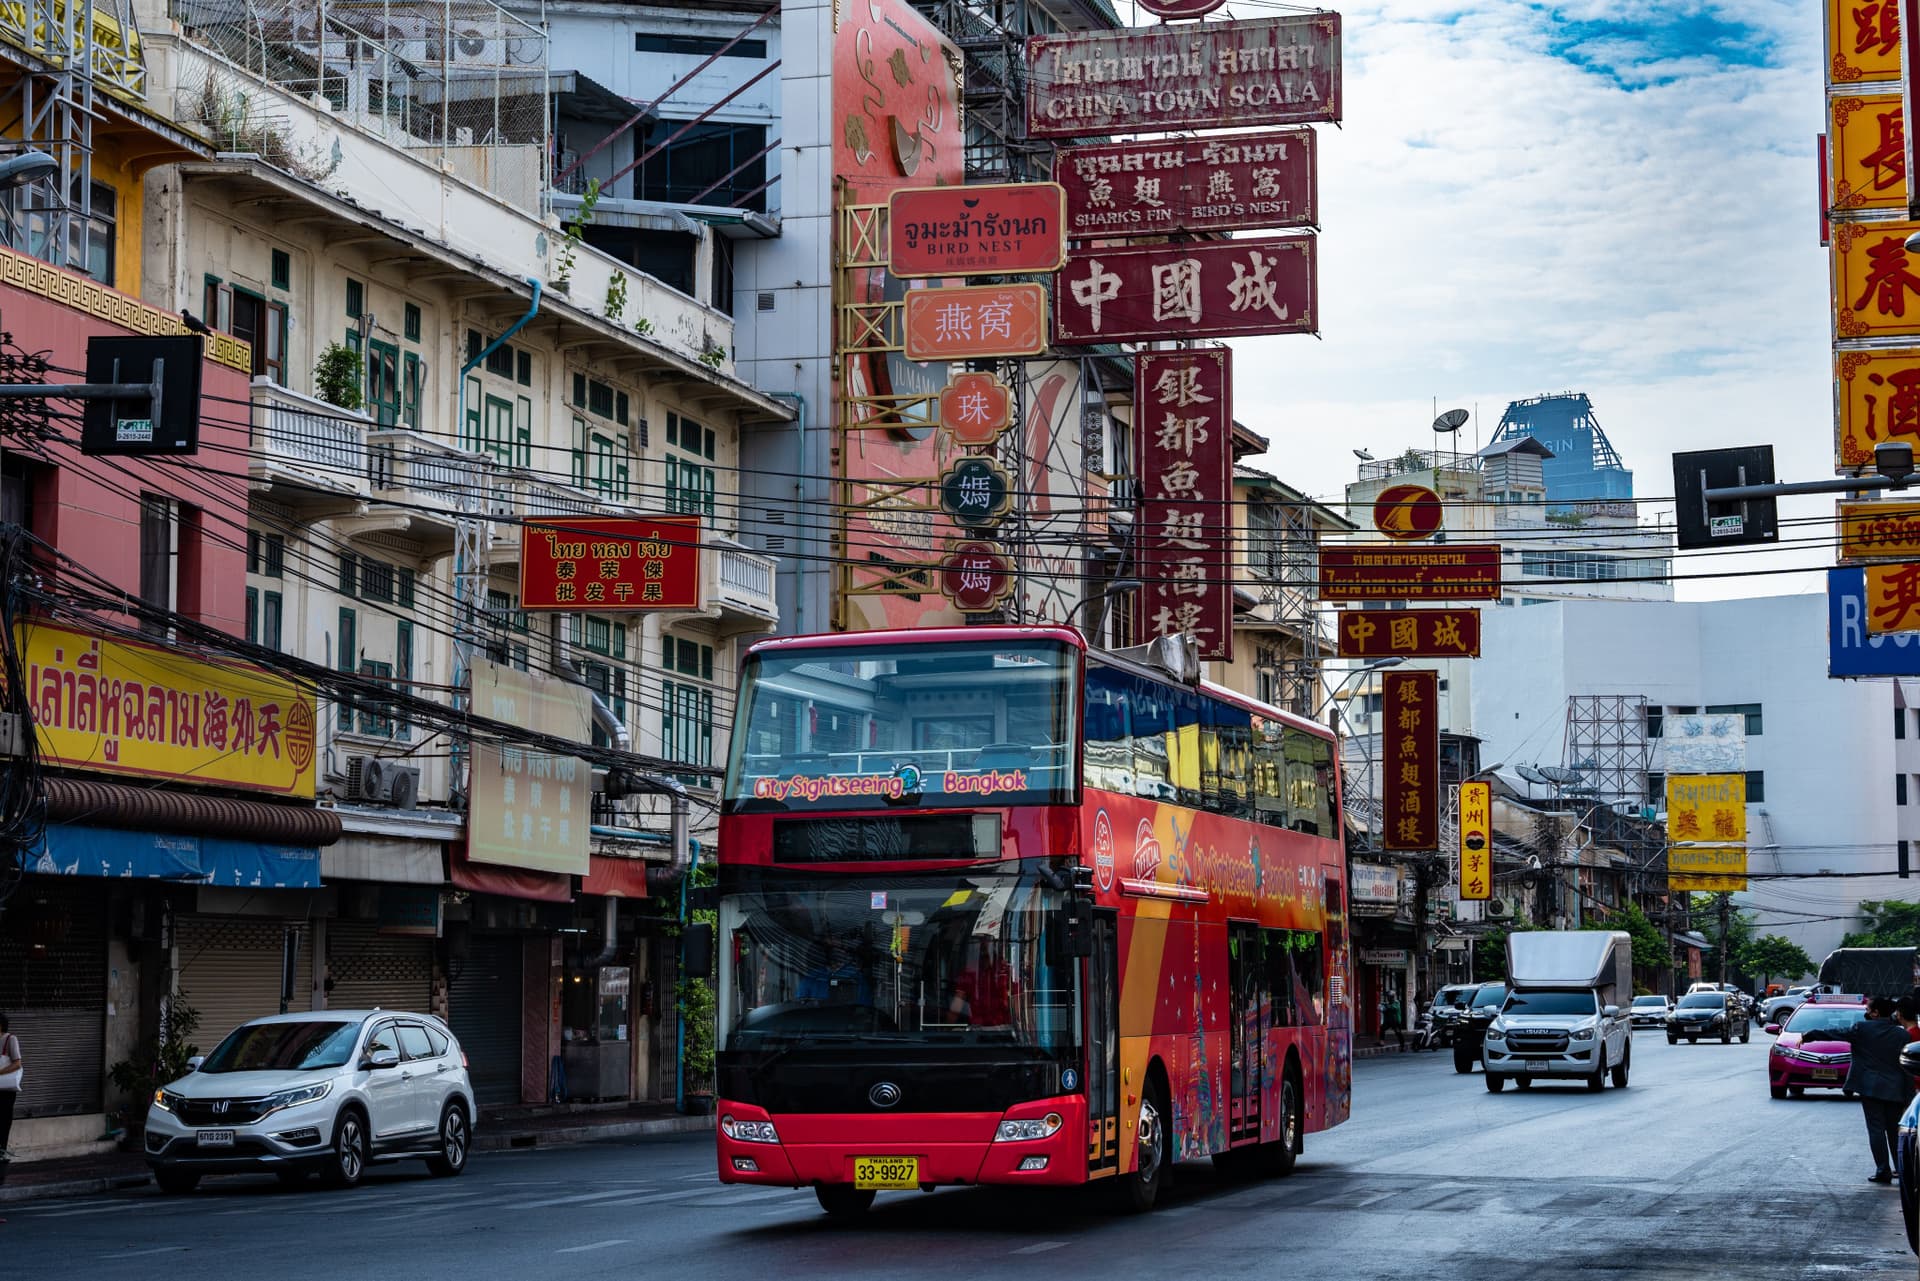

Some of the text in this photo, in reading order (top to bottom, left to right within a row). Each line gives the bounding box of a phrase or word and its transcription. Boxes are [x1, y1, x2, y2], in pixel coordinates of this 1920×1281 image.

[1047, 81, 1320, 119] CHINA TOWN SCALA
[1086, 166, 1281, 209] 魚翅 燕窩
[1075, 200, 1290, 227] SHARK'S FIN BIRD'S NEST
[927, 240, 1023, 255] BIRD NEST
[1071, 251, 1289, 332] 中國城
[1854, 236, 1920, 317] 春
[935, 301, 1014, 343] 燕窝
[958, 391, 991, 425] 珠
[1152, 366, 1215, 648] 銀都魚翅酒樓
[546, 535, 586, 559] ไทย
[591, 541, 630, 559] หลง
[556, 583, 663, 601] 批发干果
[1347, 615, 1467, 653] 中國城
[29, 639, 199, 762] เล่าลี่หูฉลาม
[203, 690, 282, 760] 海外天
[1397, 679, 1423, 843] 銀都魚翅酒樓
[943, 769, 1027, 794] Bangkok
[857, 1164, 915, 1181] 33-9927
